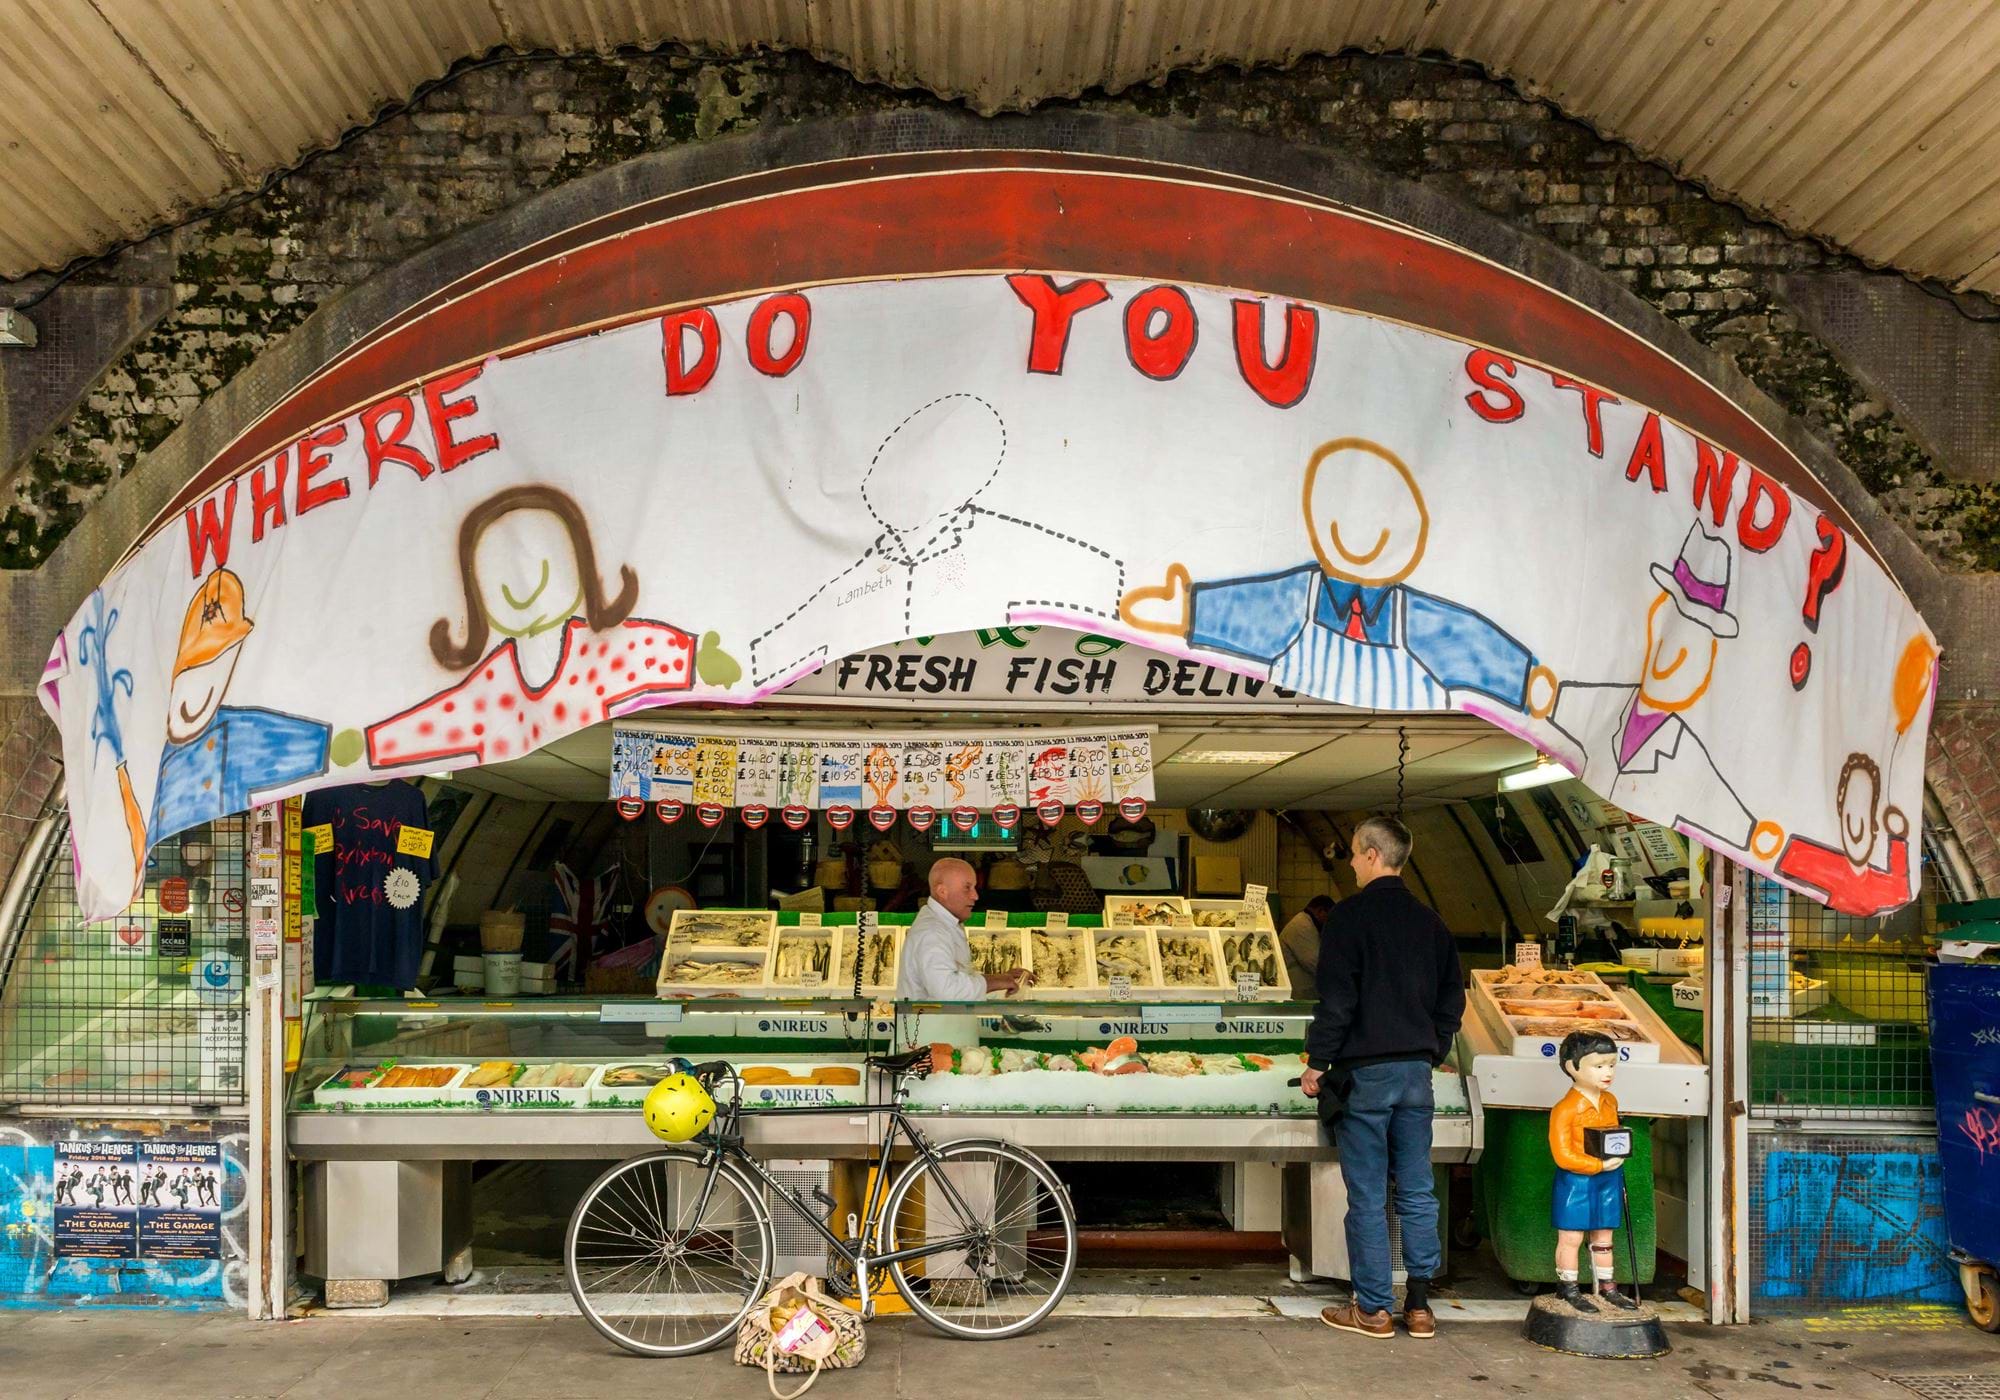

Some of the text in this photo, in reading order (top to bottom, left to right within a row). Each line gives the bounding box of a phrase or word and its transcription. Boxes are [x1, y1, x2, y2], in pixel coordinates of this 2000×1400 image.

[185, 356, 500, 579] WHERE
[661, 291, 811, 396] DO
[1004, 273, 1318, 408] YOU
[836, 574, 893, 607] Lambeth
[838, 654, 978, 694] FRESH
[1005, 657, 1117, 695] FISH
[401, 839, 427, 852] SHOPS
[392, 874, 410, 889] £10
[215, 964, 222, 973] 2
[771, 1018, 828, 1034] NIREUS
[1112, 1021, 1169, 1036] NIREUS
[1227, 1020, 1285, 1034] NIREUS
[492, 1089, 560, 1106] NIREUS
[774, 1086, 834, 1102] NIREUS
[58, 1142, 92, 1154] TANKUS
[101, 1144, 134, 1155] HENGE
[143, 1143, 176, 1155] TANKUS
[185, 1145, 217, 1156] HENGE
